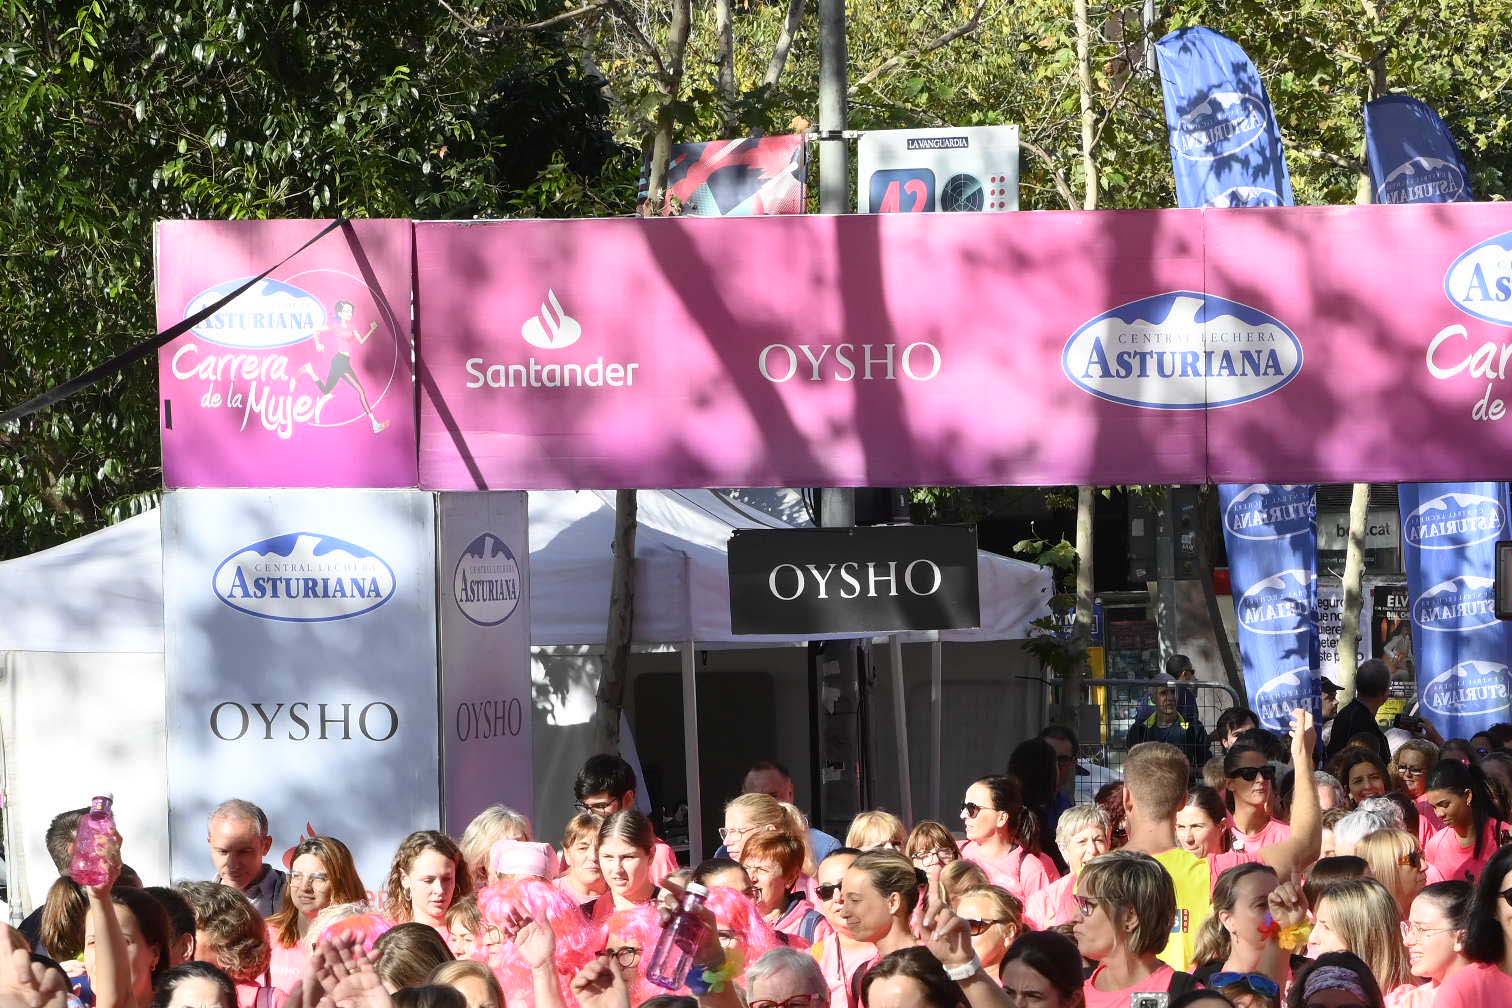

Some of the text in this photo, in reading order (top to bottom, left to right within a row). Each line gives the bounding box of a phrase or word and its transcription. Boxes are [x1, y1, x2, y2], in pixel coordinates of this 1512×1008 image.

[909, 138, 967, 149] LA VANGUARDIA
[881, 178, 928, 213] 42
[1118, 331, 1276, 344] CENTRAL LECHERA
[172, 344, 290, 381] Carrera
[465, 357, 640, 389] Santander
[758, 342, 942, 383] OYSHO
[1081, 336, 1284, 379] ASTURIANA
[200, 378, 334, 439] de la Mujer
[1472, 384, 1504, 421] de
[227, 566, 382, 599] ASTURIANA
[459, 567, 517, 603] ASTURIANA
[768, 559, 942, 601] OYSHO
[1387, 595, 1408, 607] ELV
[210, 701, 399, 742] OYSHO
[456, 698, 522, 742] OYSHO
